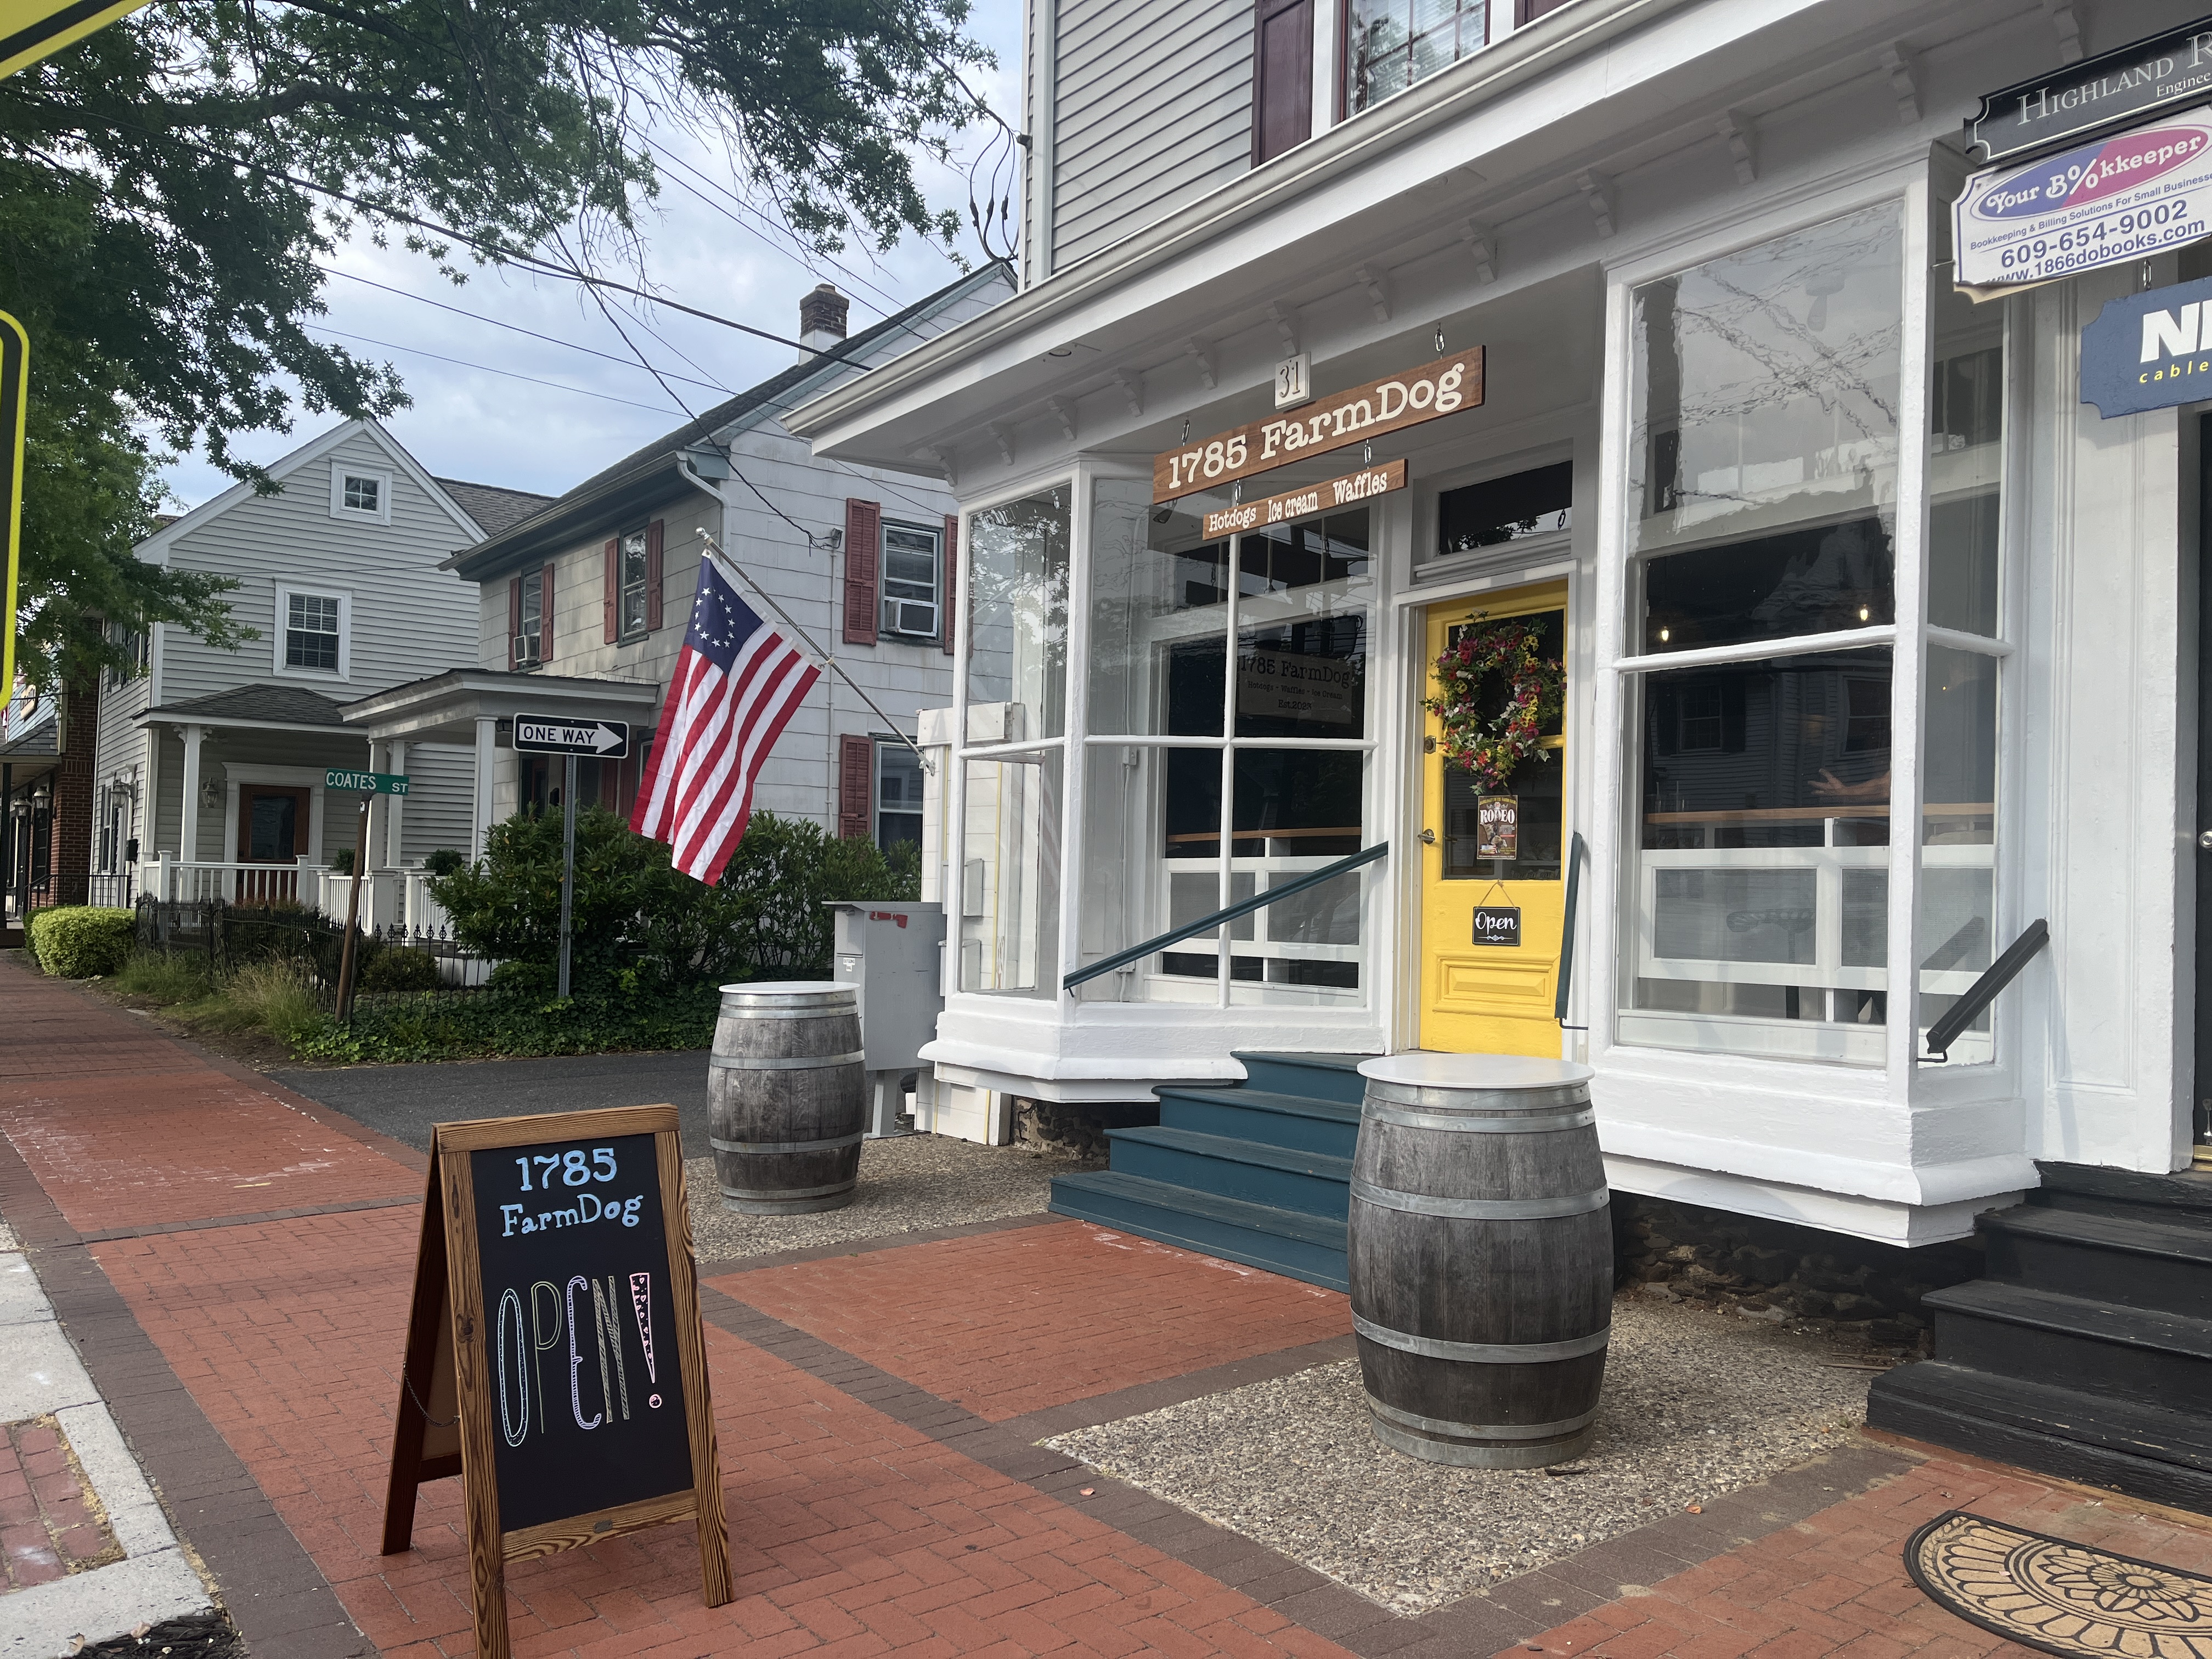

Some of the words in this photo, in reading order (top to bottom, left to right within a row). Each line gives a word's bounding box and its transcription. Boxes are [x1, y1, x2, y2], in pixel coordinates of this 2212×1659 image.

[2017, 57, 2174, 126] HIGHLAND
[2156, 72, 2212, 98] Enginee
[1986, 183, 2039, 213] Your
[1971, 228, 2027, 250] Bookkeeping
[2039, 216, 2067, 229] Billing
[2070, 202, 2113, 220] Solutions
[2116, 196, 2132, 207] For
[2134, 187, 2160, 201] Small
[2001, 199, 2187, 268] 609-654-9002
[1279, 362, 1300, 398] 31
[1168, 435, 1247, 489] 1785
[1260, 362, 1465, 460] FarmDog
[1209, 507, 1256, 532] Hotdogs
[1267, 499, 1282, 523] Ice
[1285, 492, 1318, 518] cream
[1333, 472, 1387, 504] Waffles
[1241, 655, 1276, 675] 1785
[1281, 660, 1350, 689] FarmDog
[1248, 681, 1274, 691] Hotdogs
[1281, 685, 1305, 695] Waffles
[523, 726, 556, 741] ONE
[562, 729, 595, 744] WAY
[326, 772, 377, 790] COATES
[392, 782, 408, 793] ST
[1480, 809, 1515, 824] RODEO
[1475, 911, 1517, 935] Open
[515, 1147, 617, 1191] 1785
[500, 1194, 643, 1237] FarmDog
[498, 1272, 662, 1447] OPEN!
